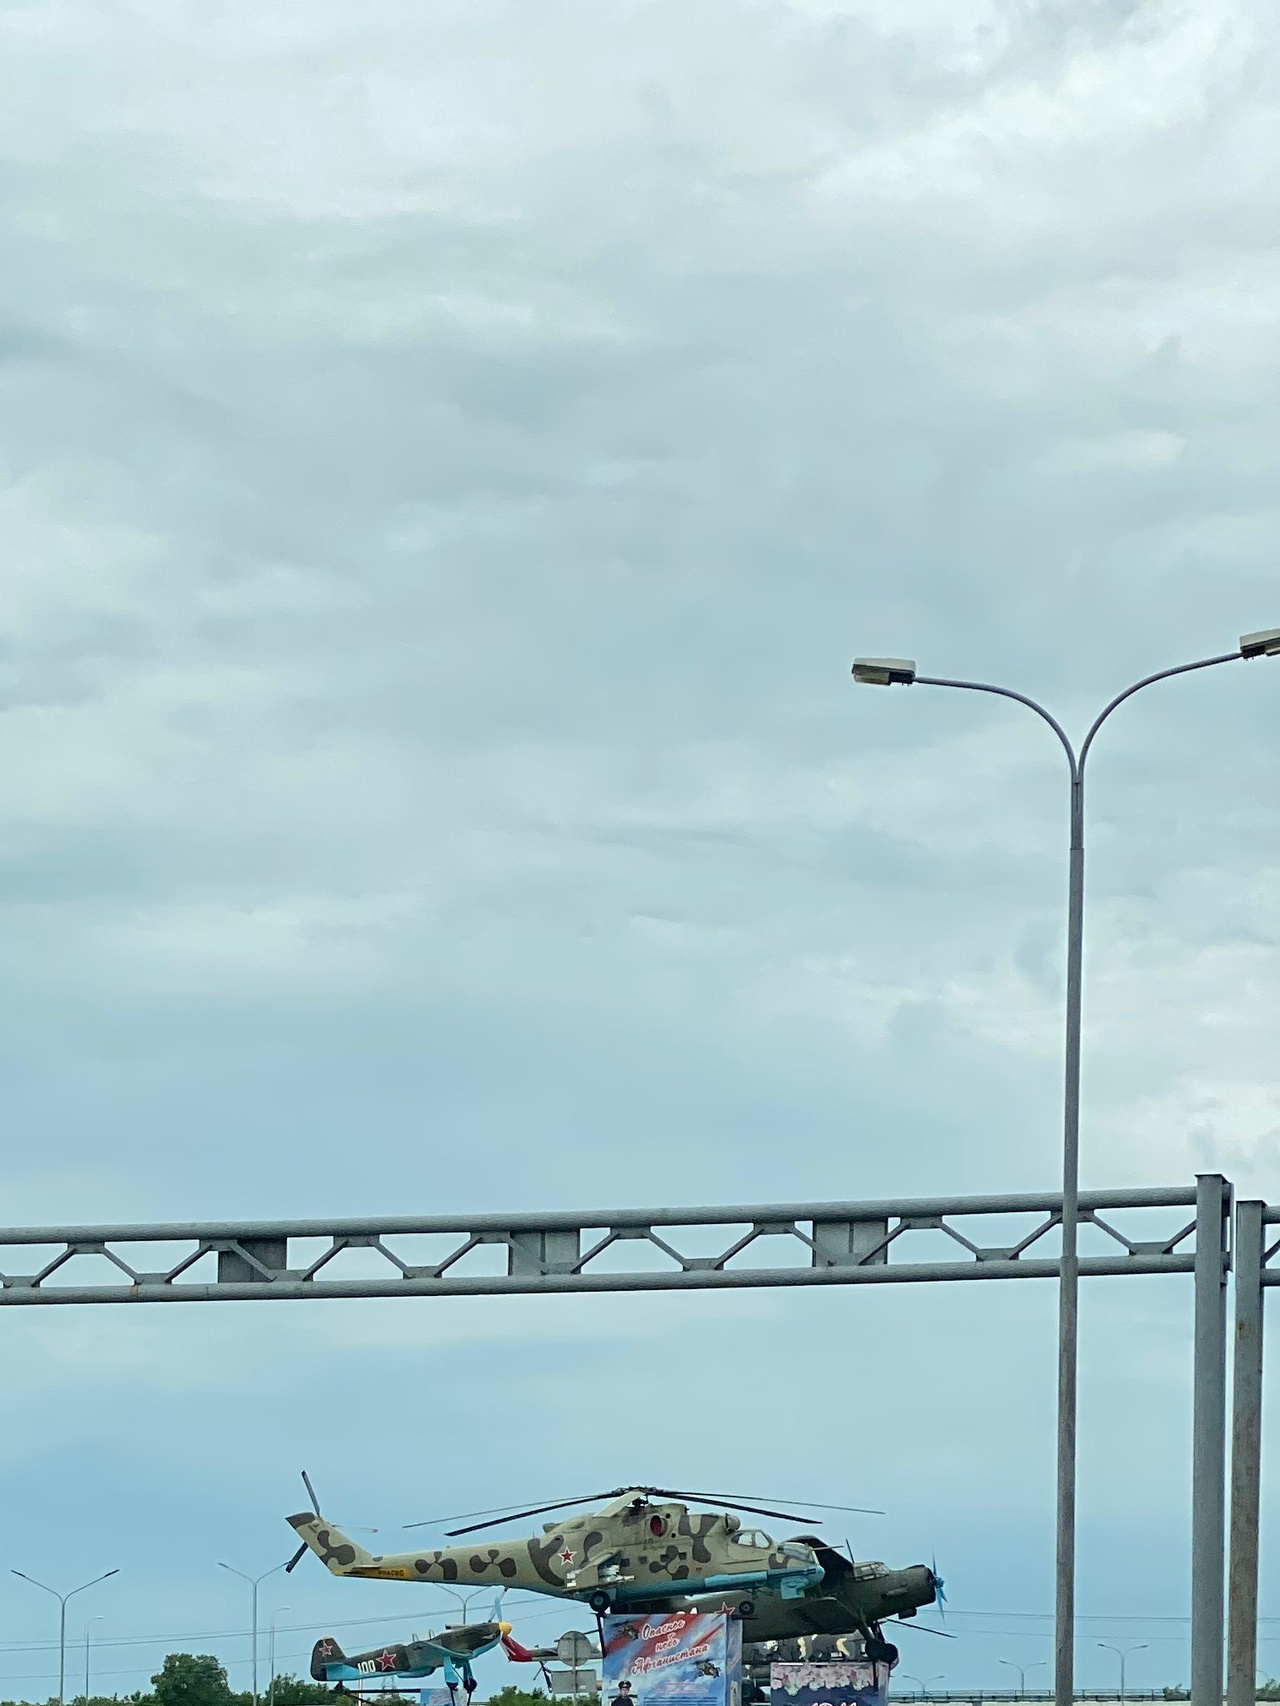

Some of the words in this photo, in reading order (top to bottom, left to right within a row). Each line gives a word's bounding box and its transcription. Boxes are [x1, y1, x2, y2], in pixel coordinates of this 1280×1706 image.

[641, 1618, 687, 1641] Опасное
[654, 1632, 680, 1653] небо
[357, 1659, 376, 1676] 100
[630, 1643, 711, 1676] Афганистана
